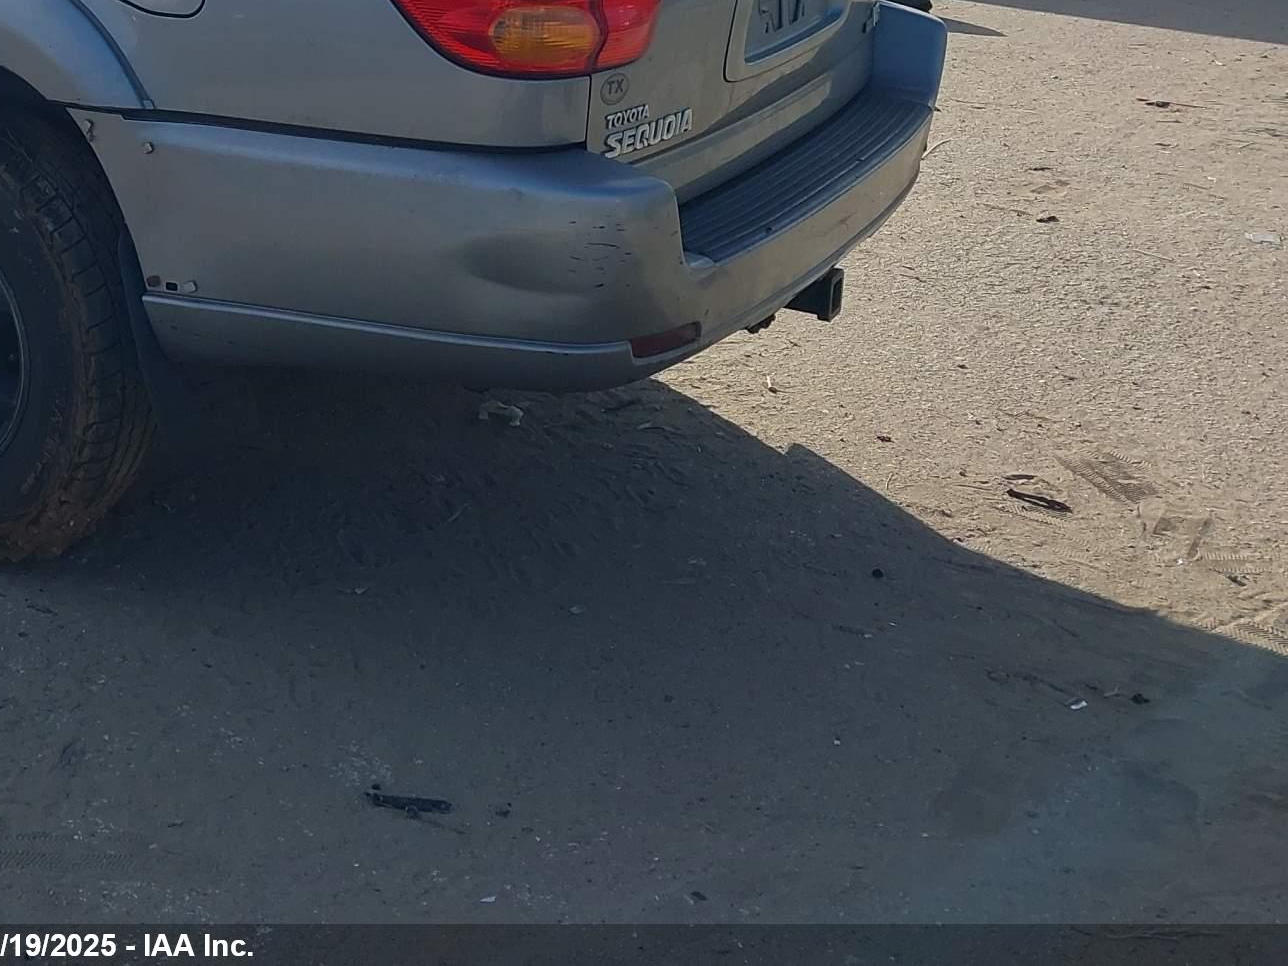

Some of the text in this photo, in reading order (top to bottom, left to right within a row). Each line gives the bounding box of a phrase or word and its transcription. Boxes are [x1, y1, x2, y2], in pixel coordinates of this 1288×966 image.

[607, 78, 625, 95] TX
[606, 104, 650, 130] TOYOTA
[605, 108, 693, 159] SEQUOIA
